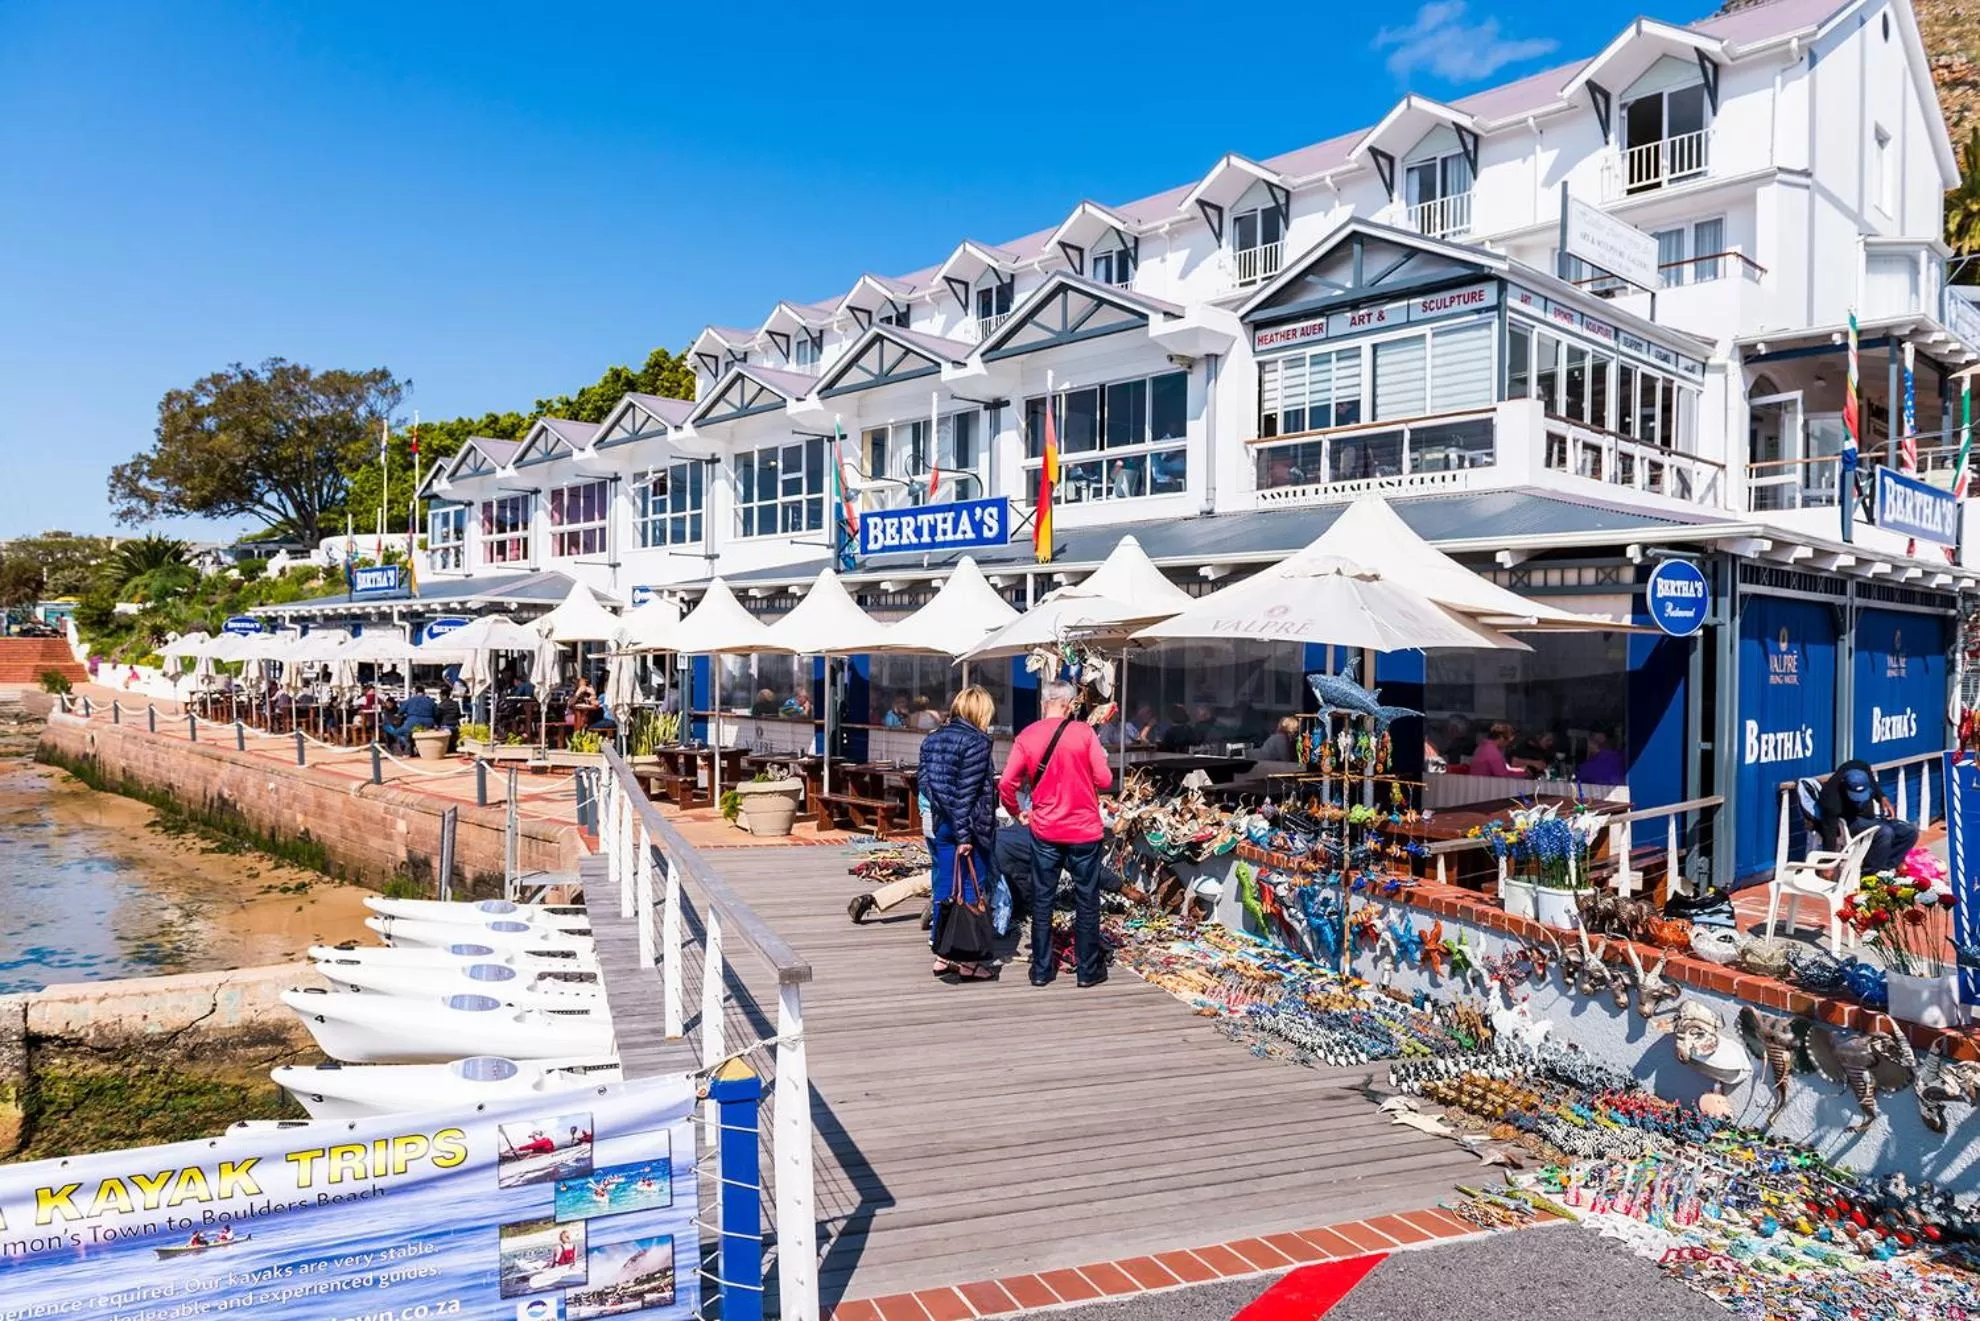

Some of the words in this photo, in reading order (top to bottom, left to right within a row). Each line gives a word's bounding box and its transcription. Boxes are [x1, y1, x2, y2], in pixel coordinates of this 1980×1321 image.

[1257, 327, 1298, 346] HEATHER
[1300, 322, 1325, 338] AUER
[1350, 313, 1373, 328] ART
[1376, 310, 1386, 322] &
[1421, 289, 1485, 313] SCULPTURE
[866, 506, 1000, 551] BERTHA'S
[1883, 475, 1954, 537] BERTHA'S
[356, 569, 396, 591] BERTHA'S
[1656, 577, 1704, 598] BERTHA'S
[1744, 719, 1814, 765] BERTHA'S
[1871, 706, 1918, 744] BERTHA'S
[34, 1156, 264, 1226] KAYAK
[285, 1127, 469, 1189] TRIPS
[88, 1222, 158, 1243] Town
[167, 1215, 193, 1230] to
[202, 1199, 308, 1226] Boulders
[317, 1183, 385, 1207] Beach
[184, 1275, 223, 1293] Our
[228, 1264, 293, 1288] kayaks
[299, 1259, 329, 1275] are
[334, 1251, 374, 1269] very
[379, 1241, 440, 1262] stable.
[218, 1290, 253, 1310] and
[259, 1272, 374, 1304] experienced
[378, 1264, 442, 1289] guides.
